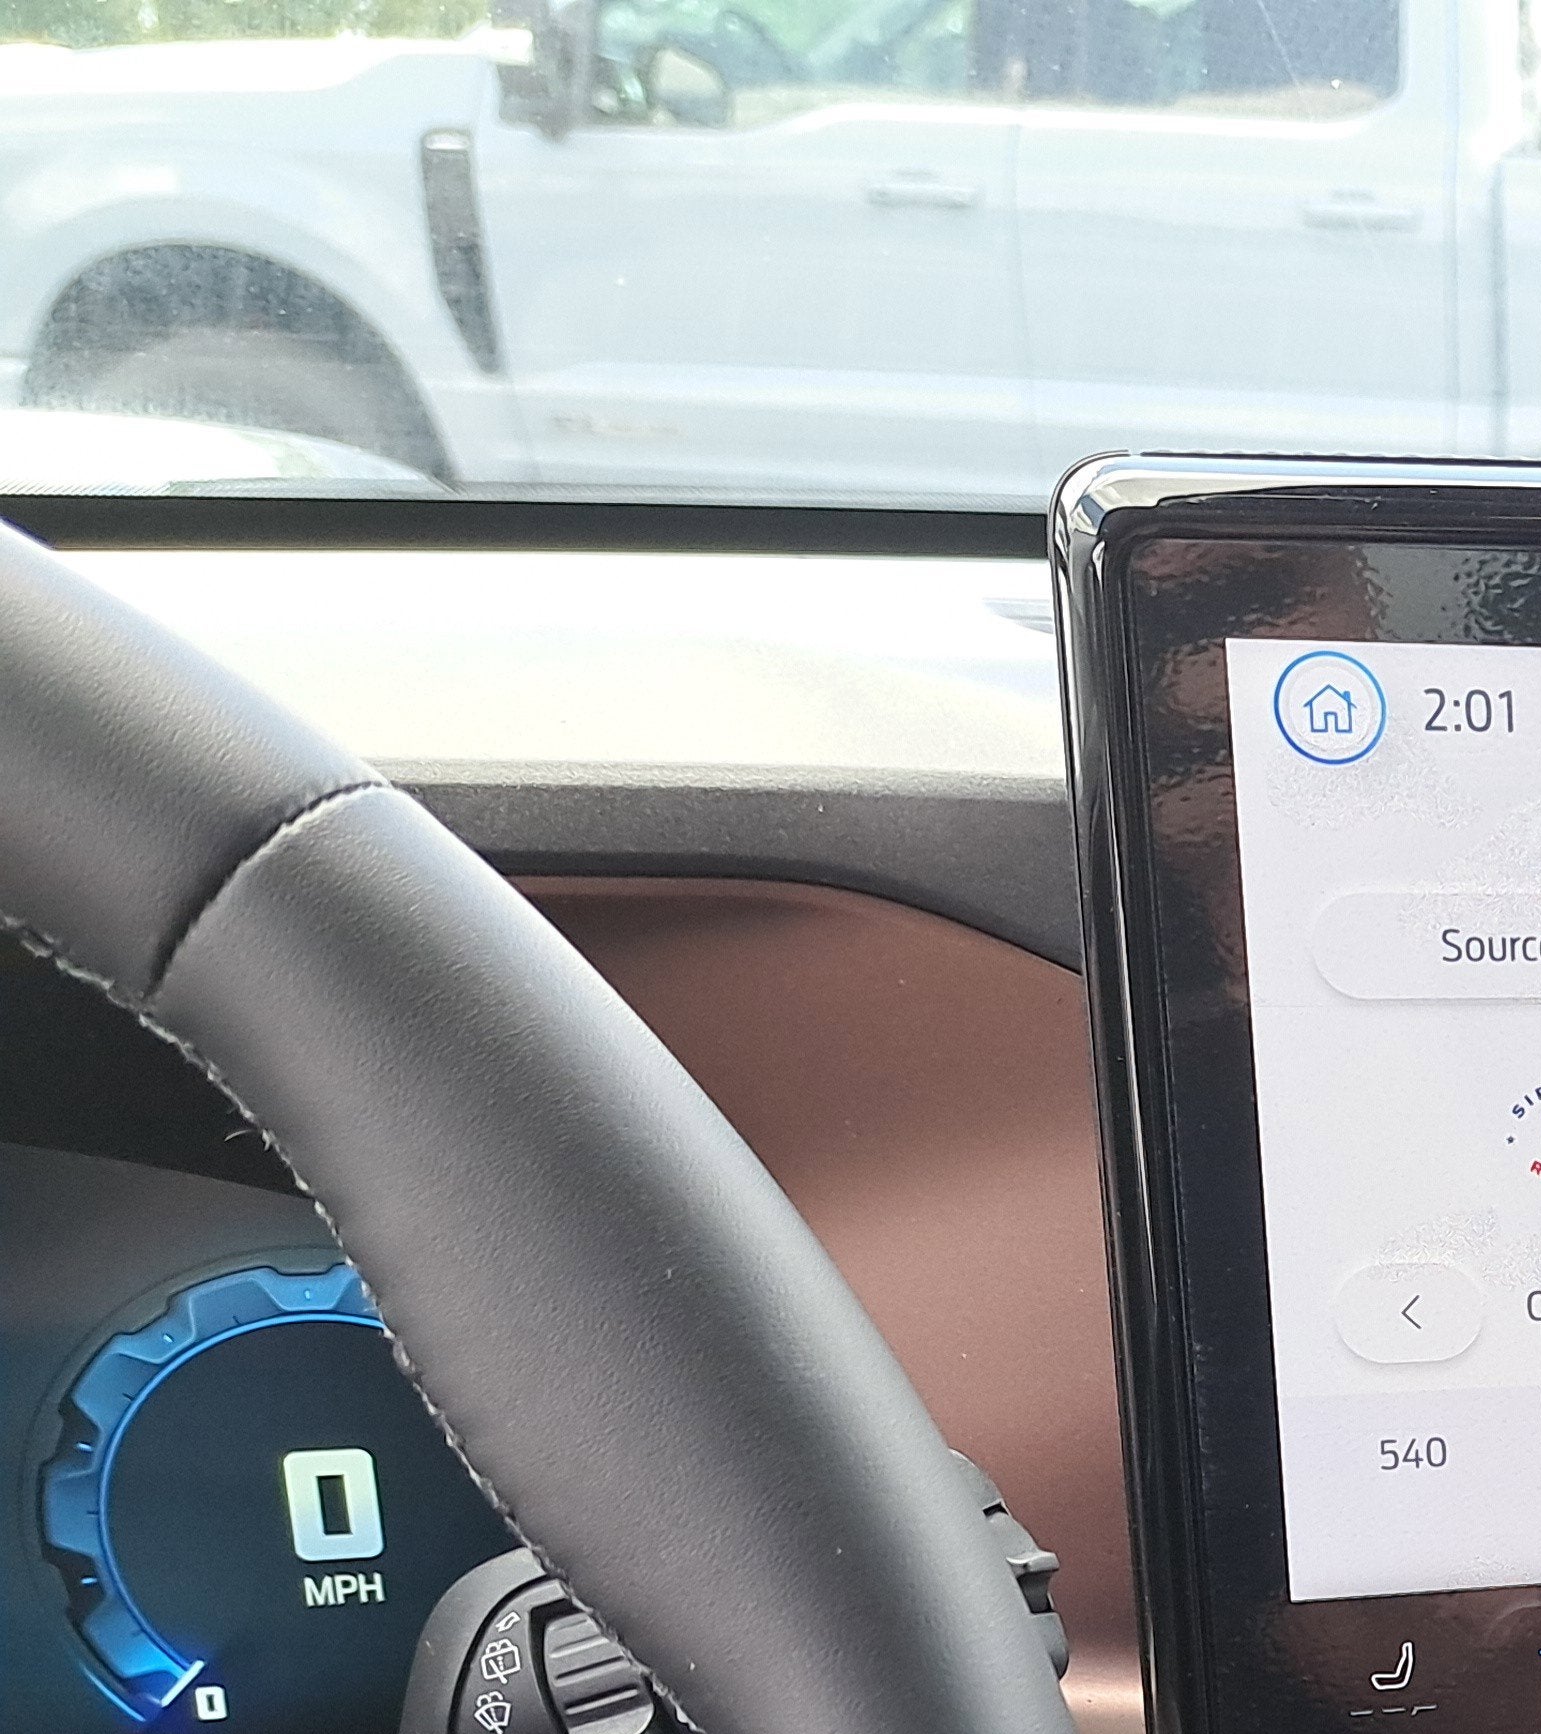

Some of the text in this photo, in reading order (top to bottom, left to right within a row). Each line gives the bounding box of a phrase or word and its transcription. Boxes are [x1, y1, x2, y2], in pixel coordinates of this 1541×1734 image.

[1423, 687, 1516, 734] 2:01
[1380, 1437, 1447, 1470] 540
[283, 1448, 384, 1561] 0
[304, 1572, 384, 1608] MPH
[195, 1686, 226, 1720] 0
